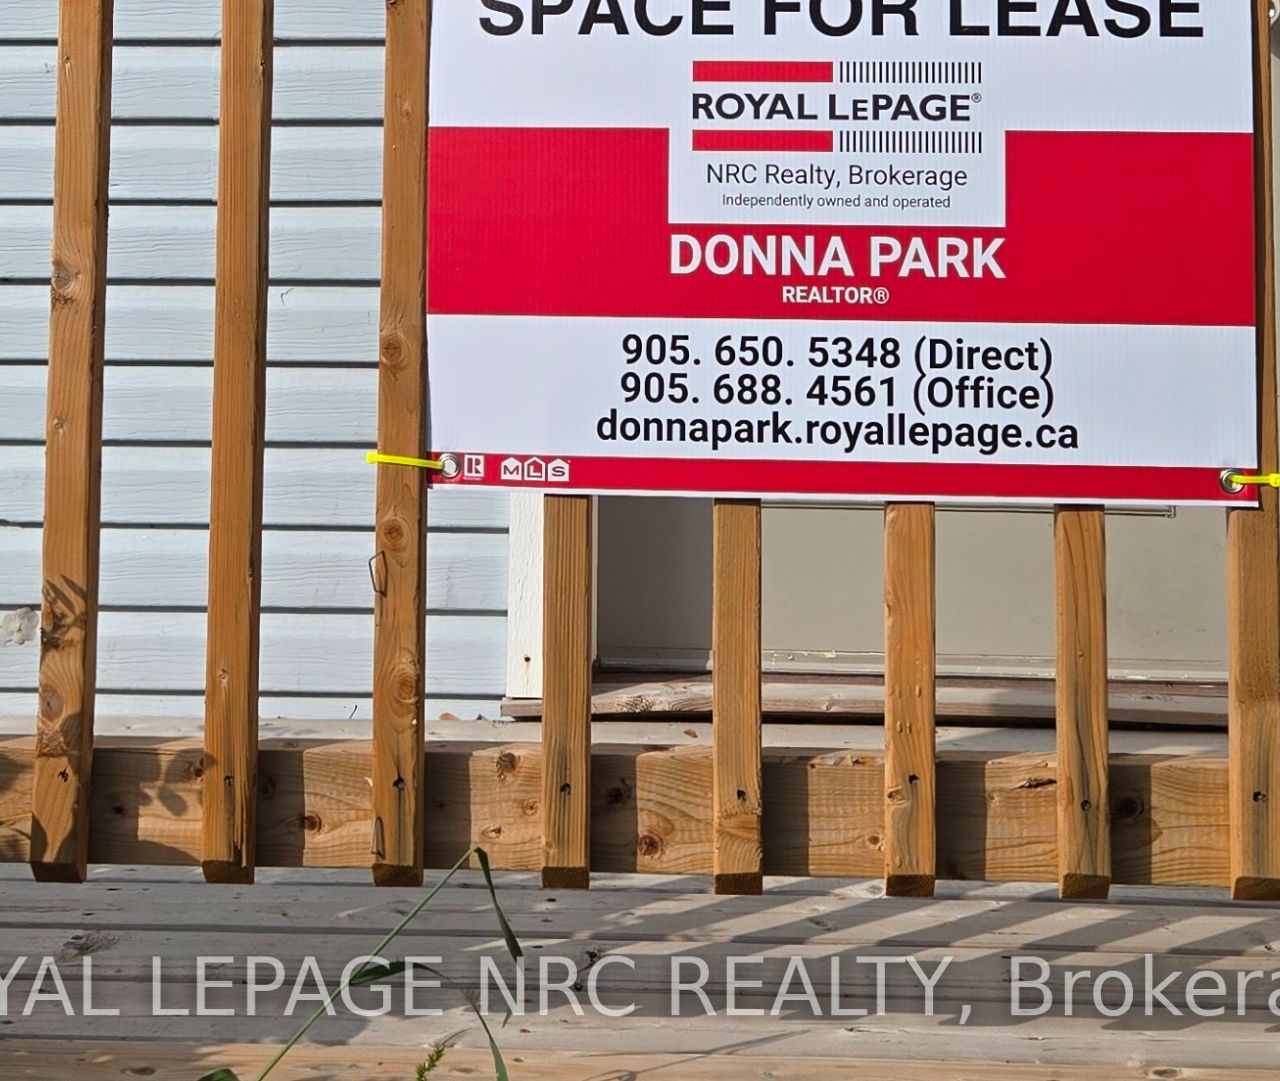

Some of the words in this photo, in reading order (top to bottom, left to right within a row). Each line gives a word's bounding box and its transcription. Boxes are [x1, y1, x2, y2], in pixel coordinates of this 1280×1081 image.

[692, 92, 818, 120] ROYAL
[707, 163, 757, 184] NRC
[765, 163, 840, 190] Realty,
[849, 164, 968, 191] Brokerage
[722, 193, 814, 209] Independently
[817, 194, 861, 208] owned
[864, 195, 888, 208] and
[892, 196, 951, 210] operated
[670, 234, 855, 277] DONNA
[870, 235, 1007, 279] PARK
[622, 333, 701, 366] 905.
[714, 334, 794, 367] 650.
[808, 336, 901, 369] 5348
[914, 336, 1053, 376] (Direct)
[620, 371, 700, 404] 905.
[713, 373, 793, 406] 688.
[806, 375, 894, 407] 4561
[913, 375, 1054, 418] (Office)
[596, 408, 1079, 455] donnapark.royallepage.ca
[502, 459, 568, 480] MLS
